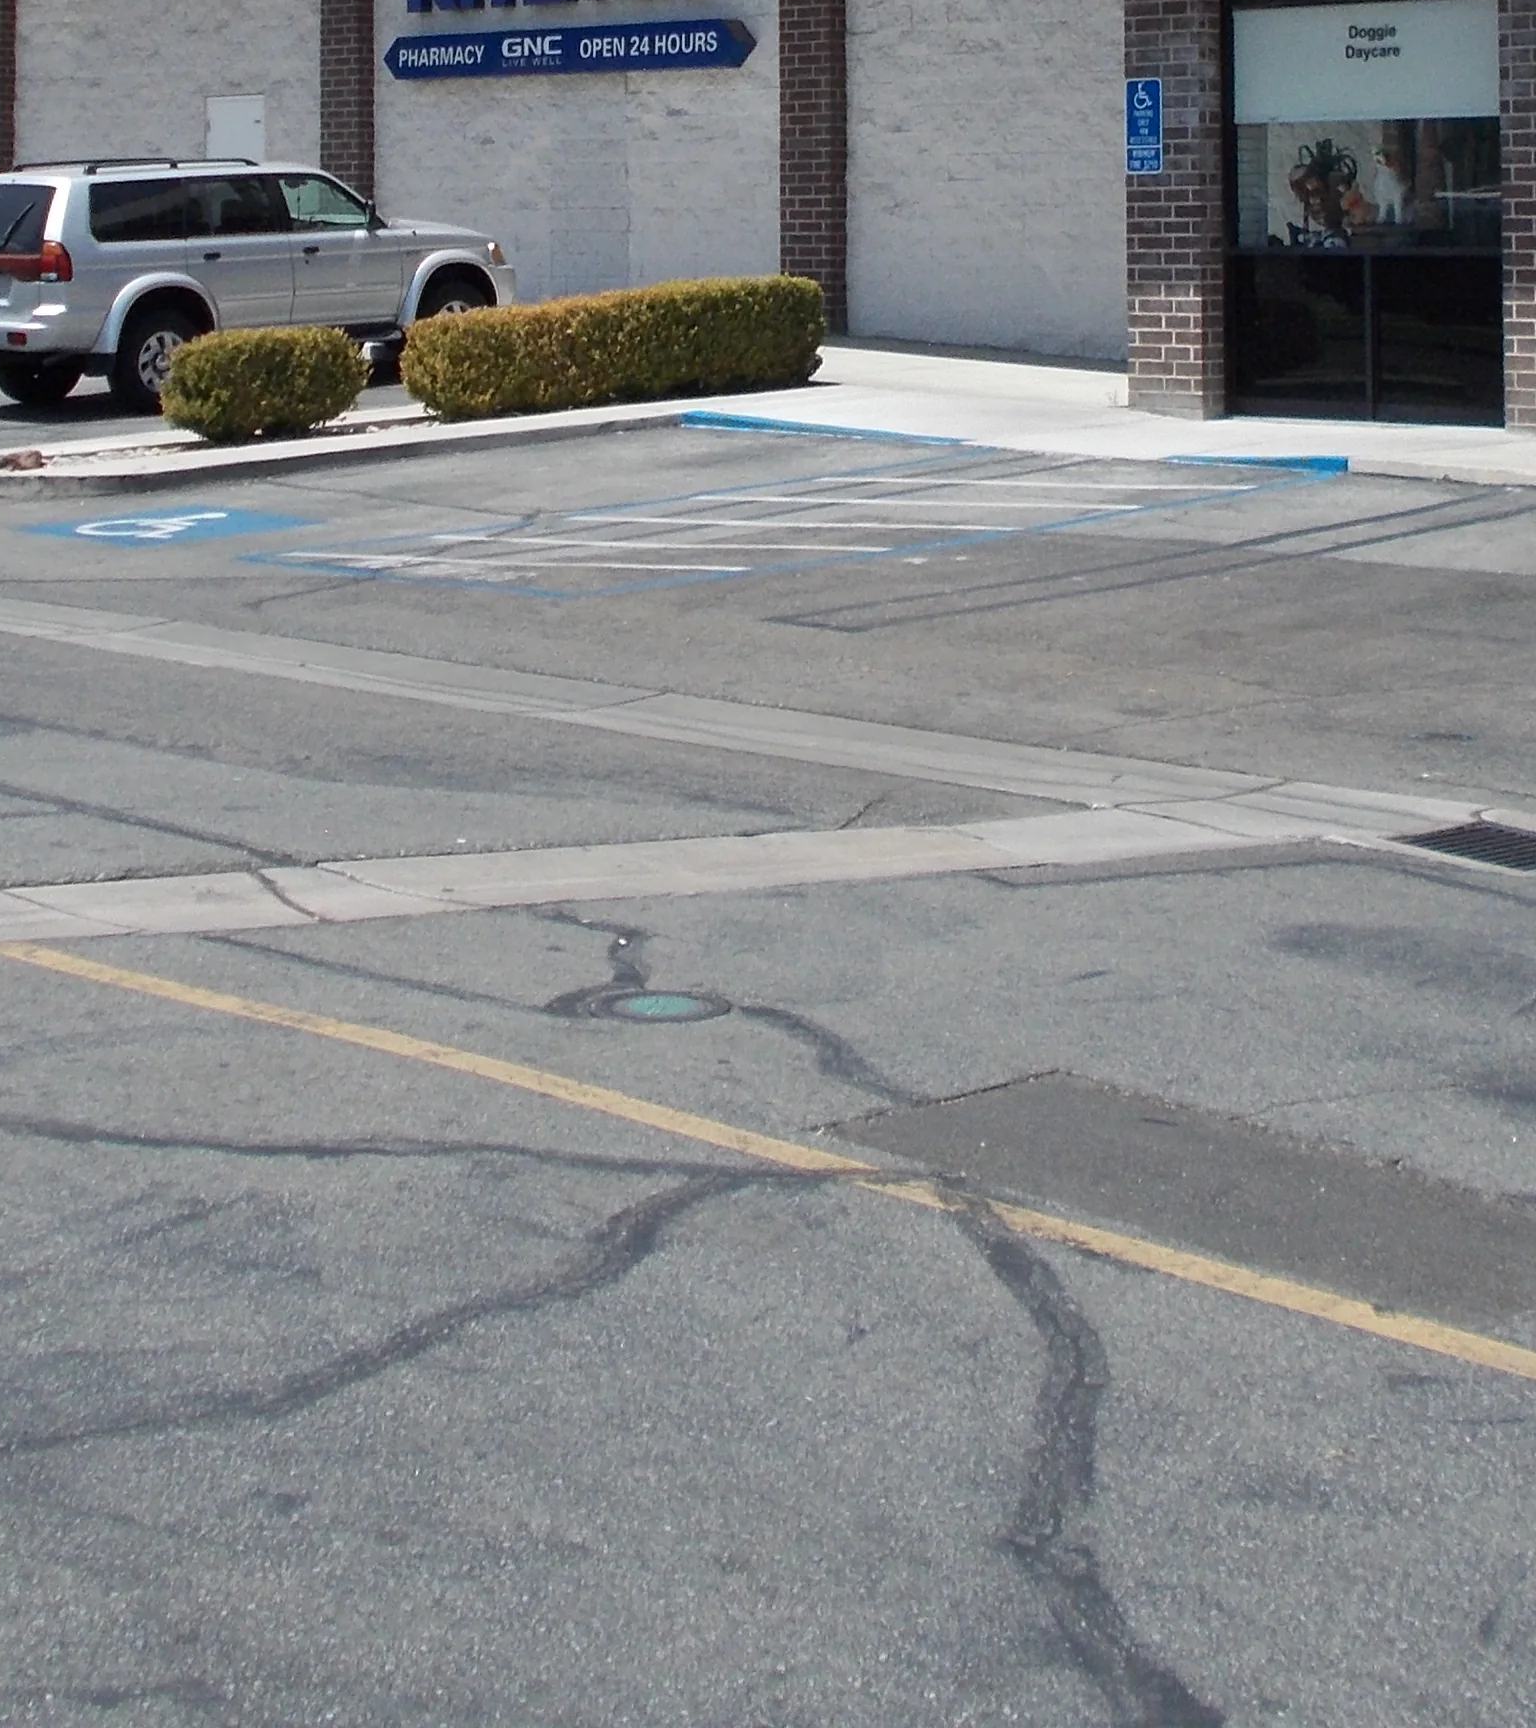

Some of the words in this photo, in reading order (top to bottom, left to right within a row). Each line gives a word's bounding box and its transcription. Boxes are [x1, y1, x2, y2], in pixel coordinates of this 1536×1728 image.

[1348, 24, 1397, 42] Doggie
[501, 35, 563, 58] GNC
[579, 36, 625, 59] OPEN
[629, 35, 651, 57] 24
[654, 30, 719, 54] HOURS
[1345, 45, 1400, 62] Daycare
[398, 44, 485, 68] PHARMACY
[532, 56, 562, 66] WELL
